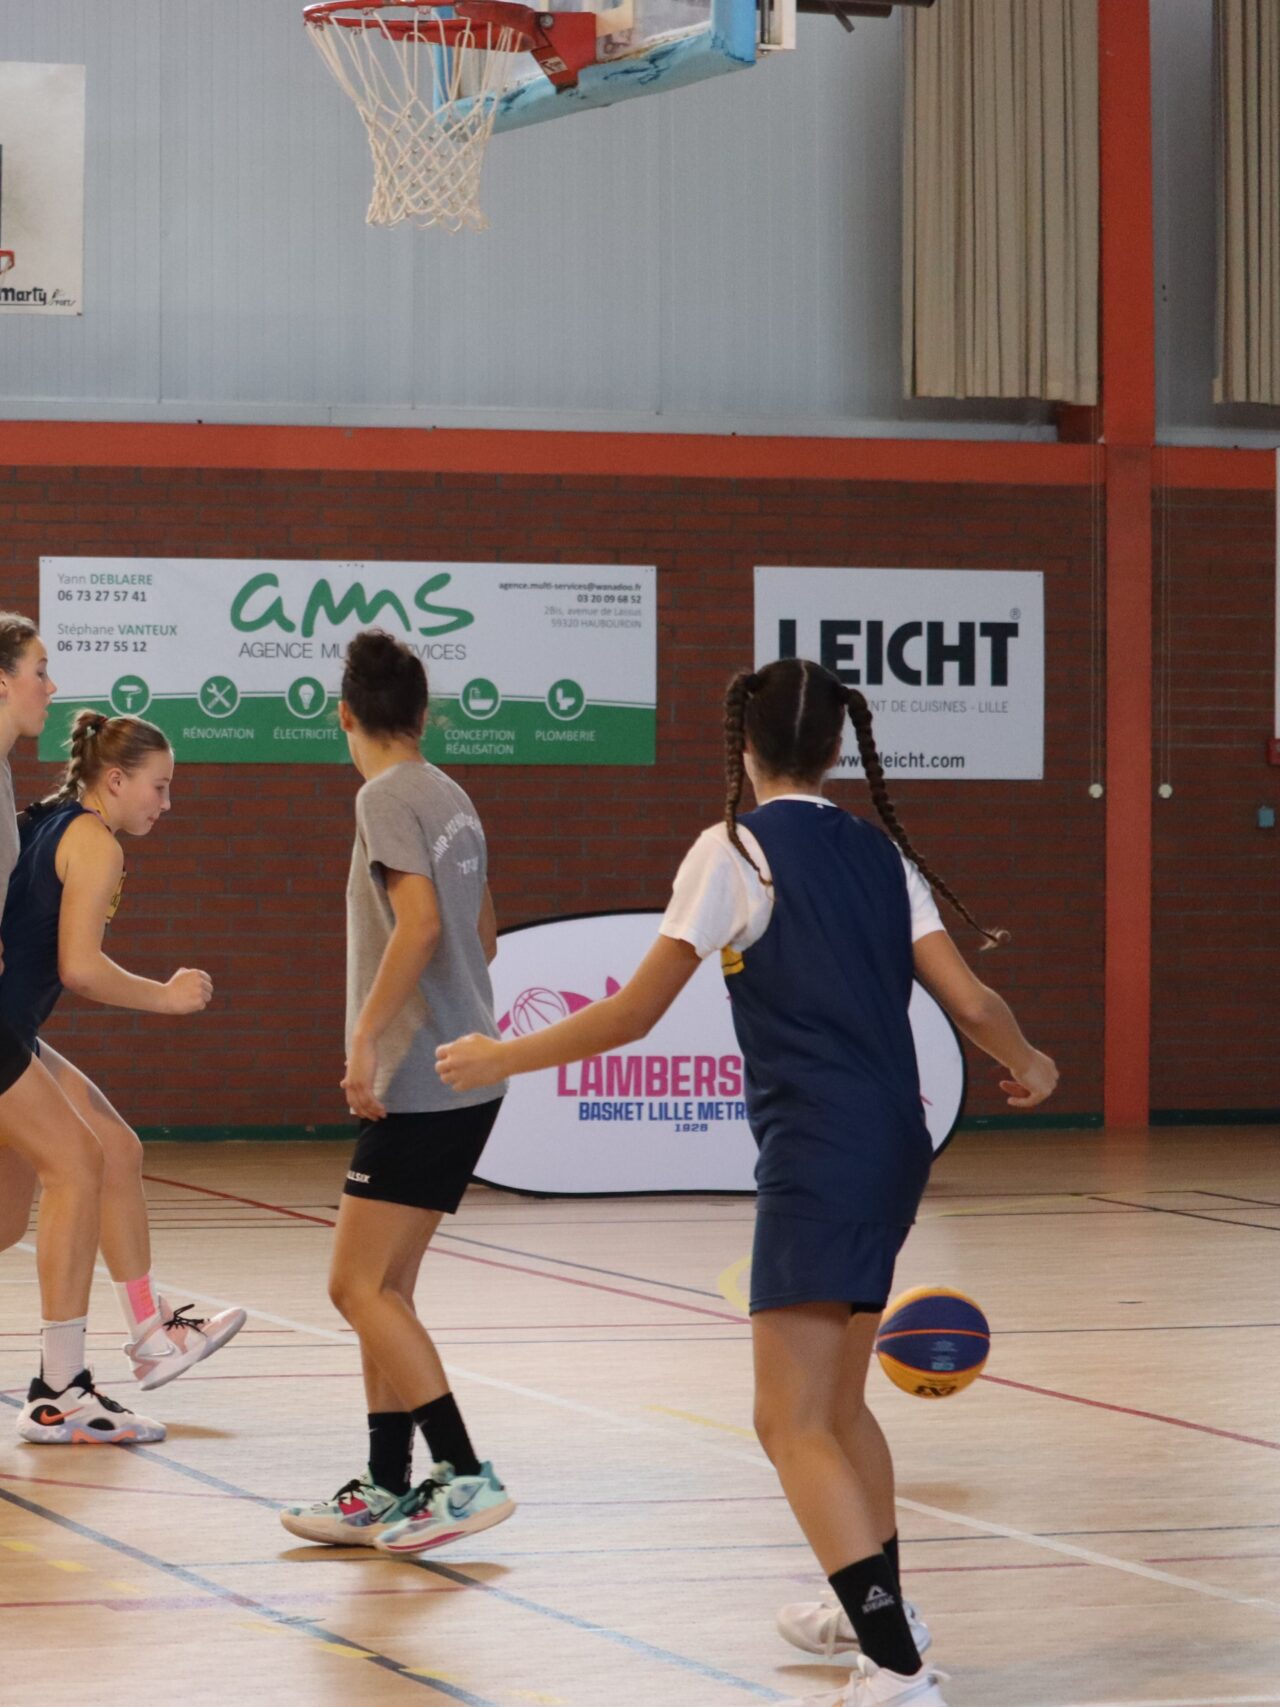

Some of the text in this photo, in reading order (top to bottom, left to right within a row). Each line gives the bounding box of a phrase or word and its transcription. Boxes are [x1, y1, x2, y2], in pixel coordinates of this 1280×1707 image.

[57, 573, 153, 585] Yann DEBLAERE
[57, 590, 147, 602] 06 73 27 57 41
[577, 594, 589, 603] 03
[591, 594, 602, 603] 20
[57, 623, 178, 636] Stéphane VANTEUX
[57, 640, 147, 652] 06 73 27 55 12
[238, 642, 467, 660] AGENCE MU VICES
[891, 701, 907, 713] DE
[910, 701, 967, 713] CUISINES
[978, 701, 1009, 714] LILLE
[182, 727, 339, 740] RÉNOVATION ÉLECTRICITÉ
[444, 729, 515, 741] CONCEPTION
[535, 730, 596, 742] PLOMBERIE
[446, 742, 514, 755] RÉALISATION
[557, 1054, 742, 1097] LAMBERS
[579, 1102, 746, 1121] BASKET LILLE METR
